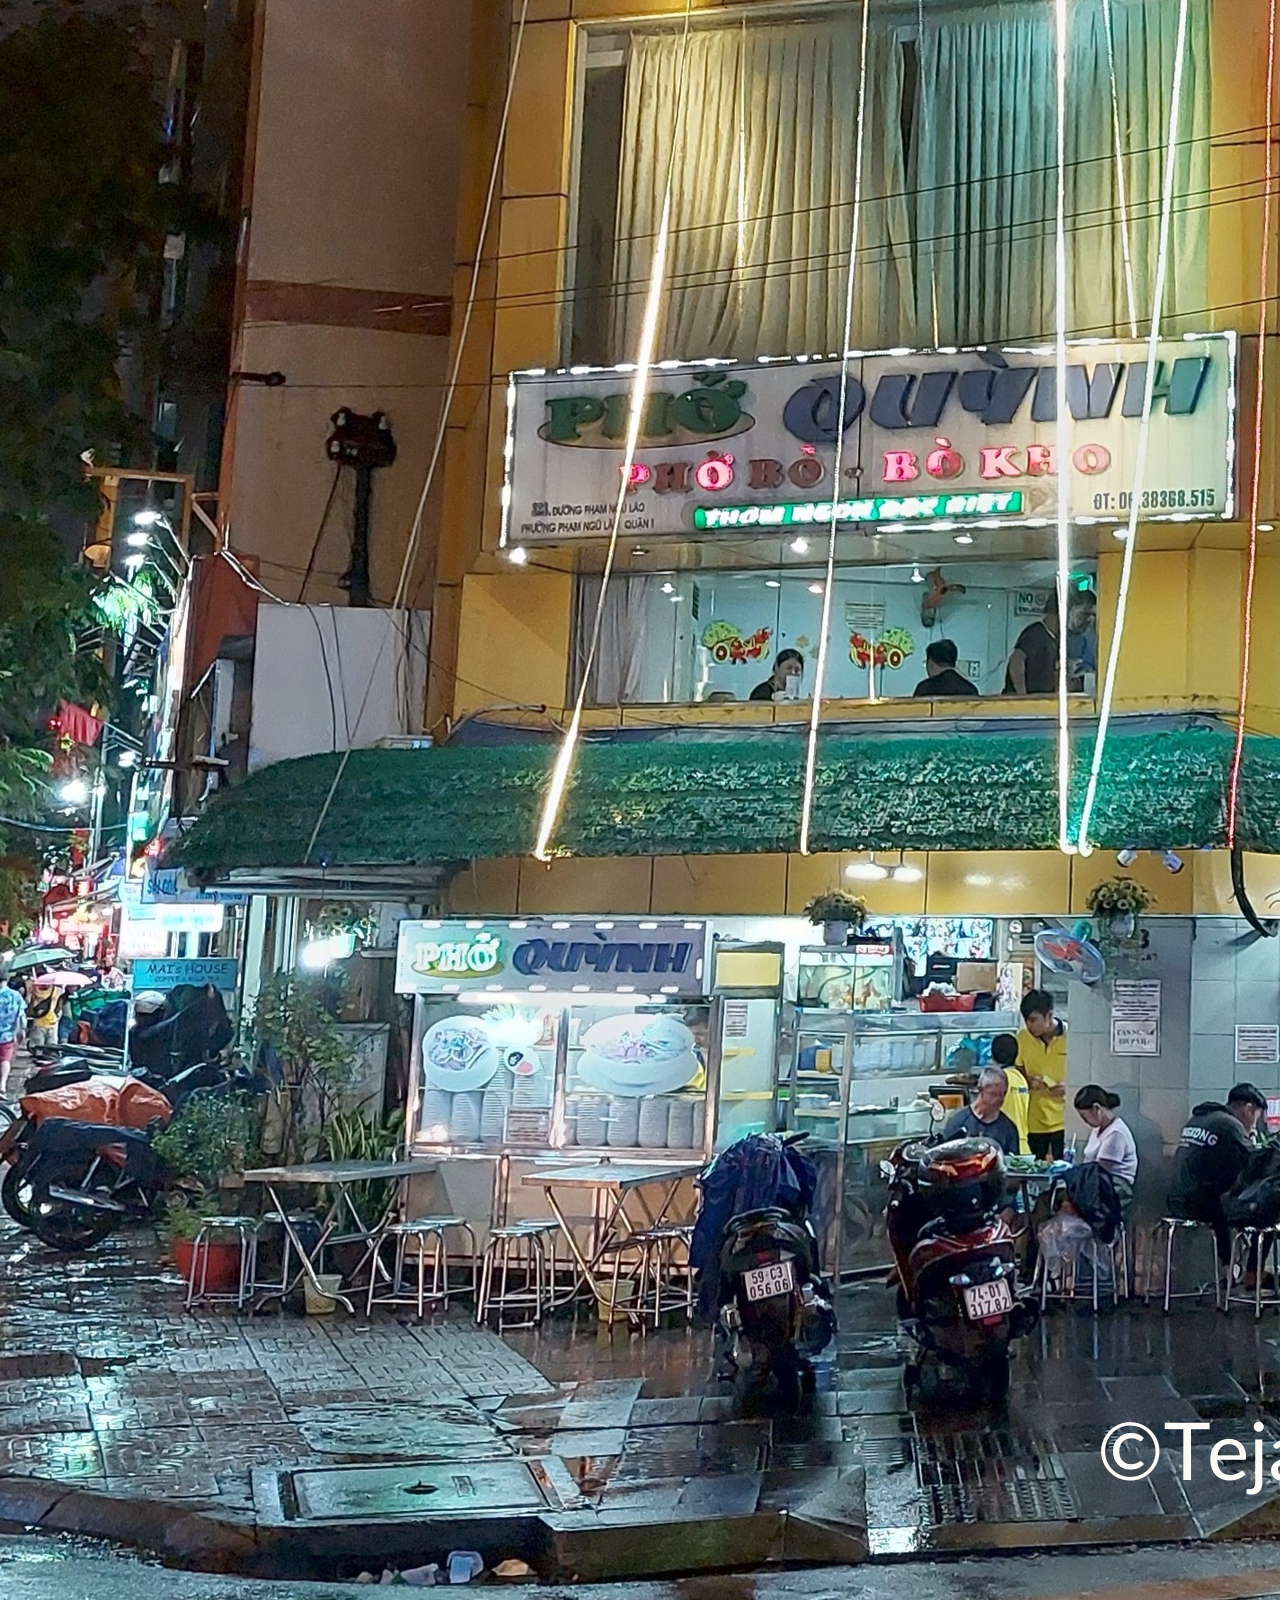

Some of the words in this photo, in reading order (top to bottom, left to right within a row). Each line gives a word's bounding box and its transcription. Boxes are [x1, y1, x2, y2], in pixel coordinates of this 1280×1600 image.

[545, 372, 749, 441] PHỞ
[783, 352, 1211, 443] QUỲNH
[619, 449, 735, 492] PHỞ
[882, 437, 965, 483] BÒ
[979, 443, 1112, 477] KHO
[185, 962, 228, 975] HOUSE
[415, 931, 500, 972] PHỞ
[512, 932, 693, 976] QUỲNH
